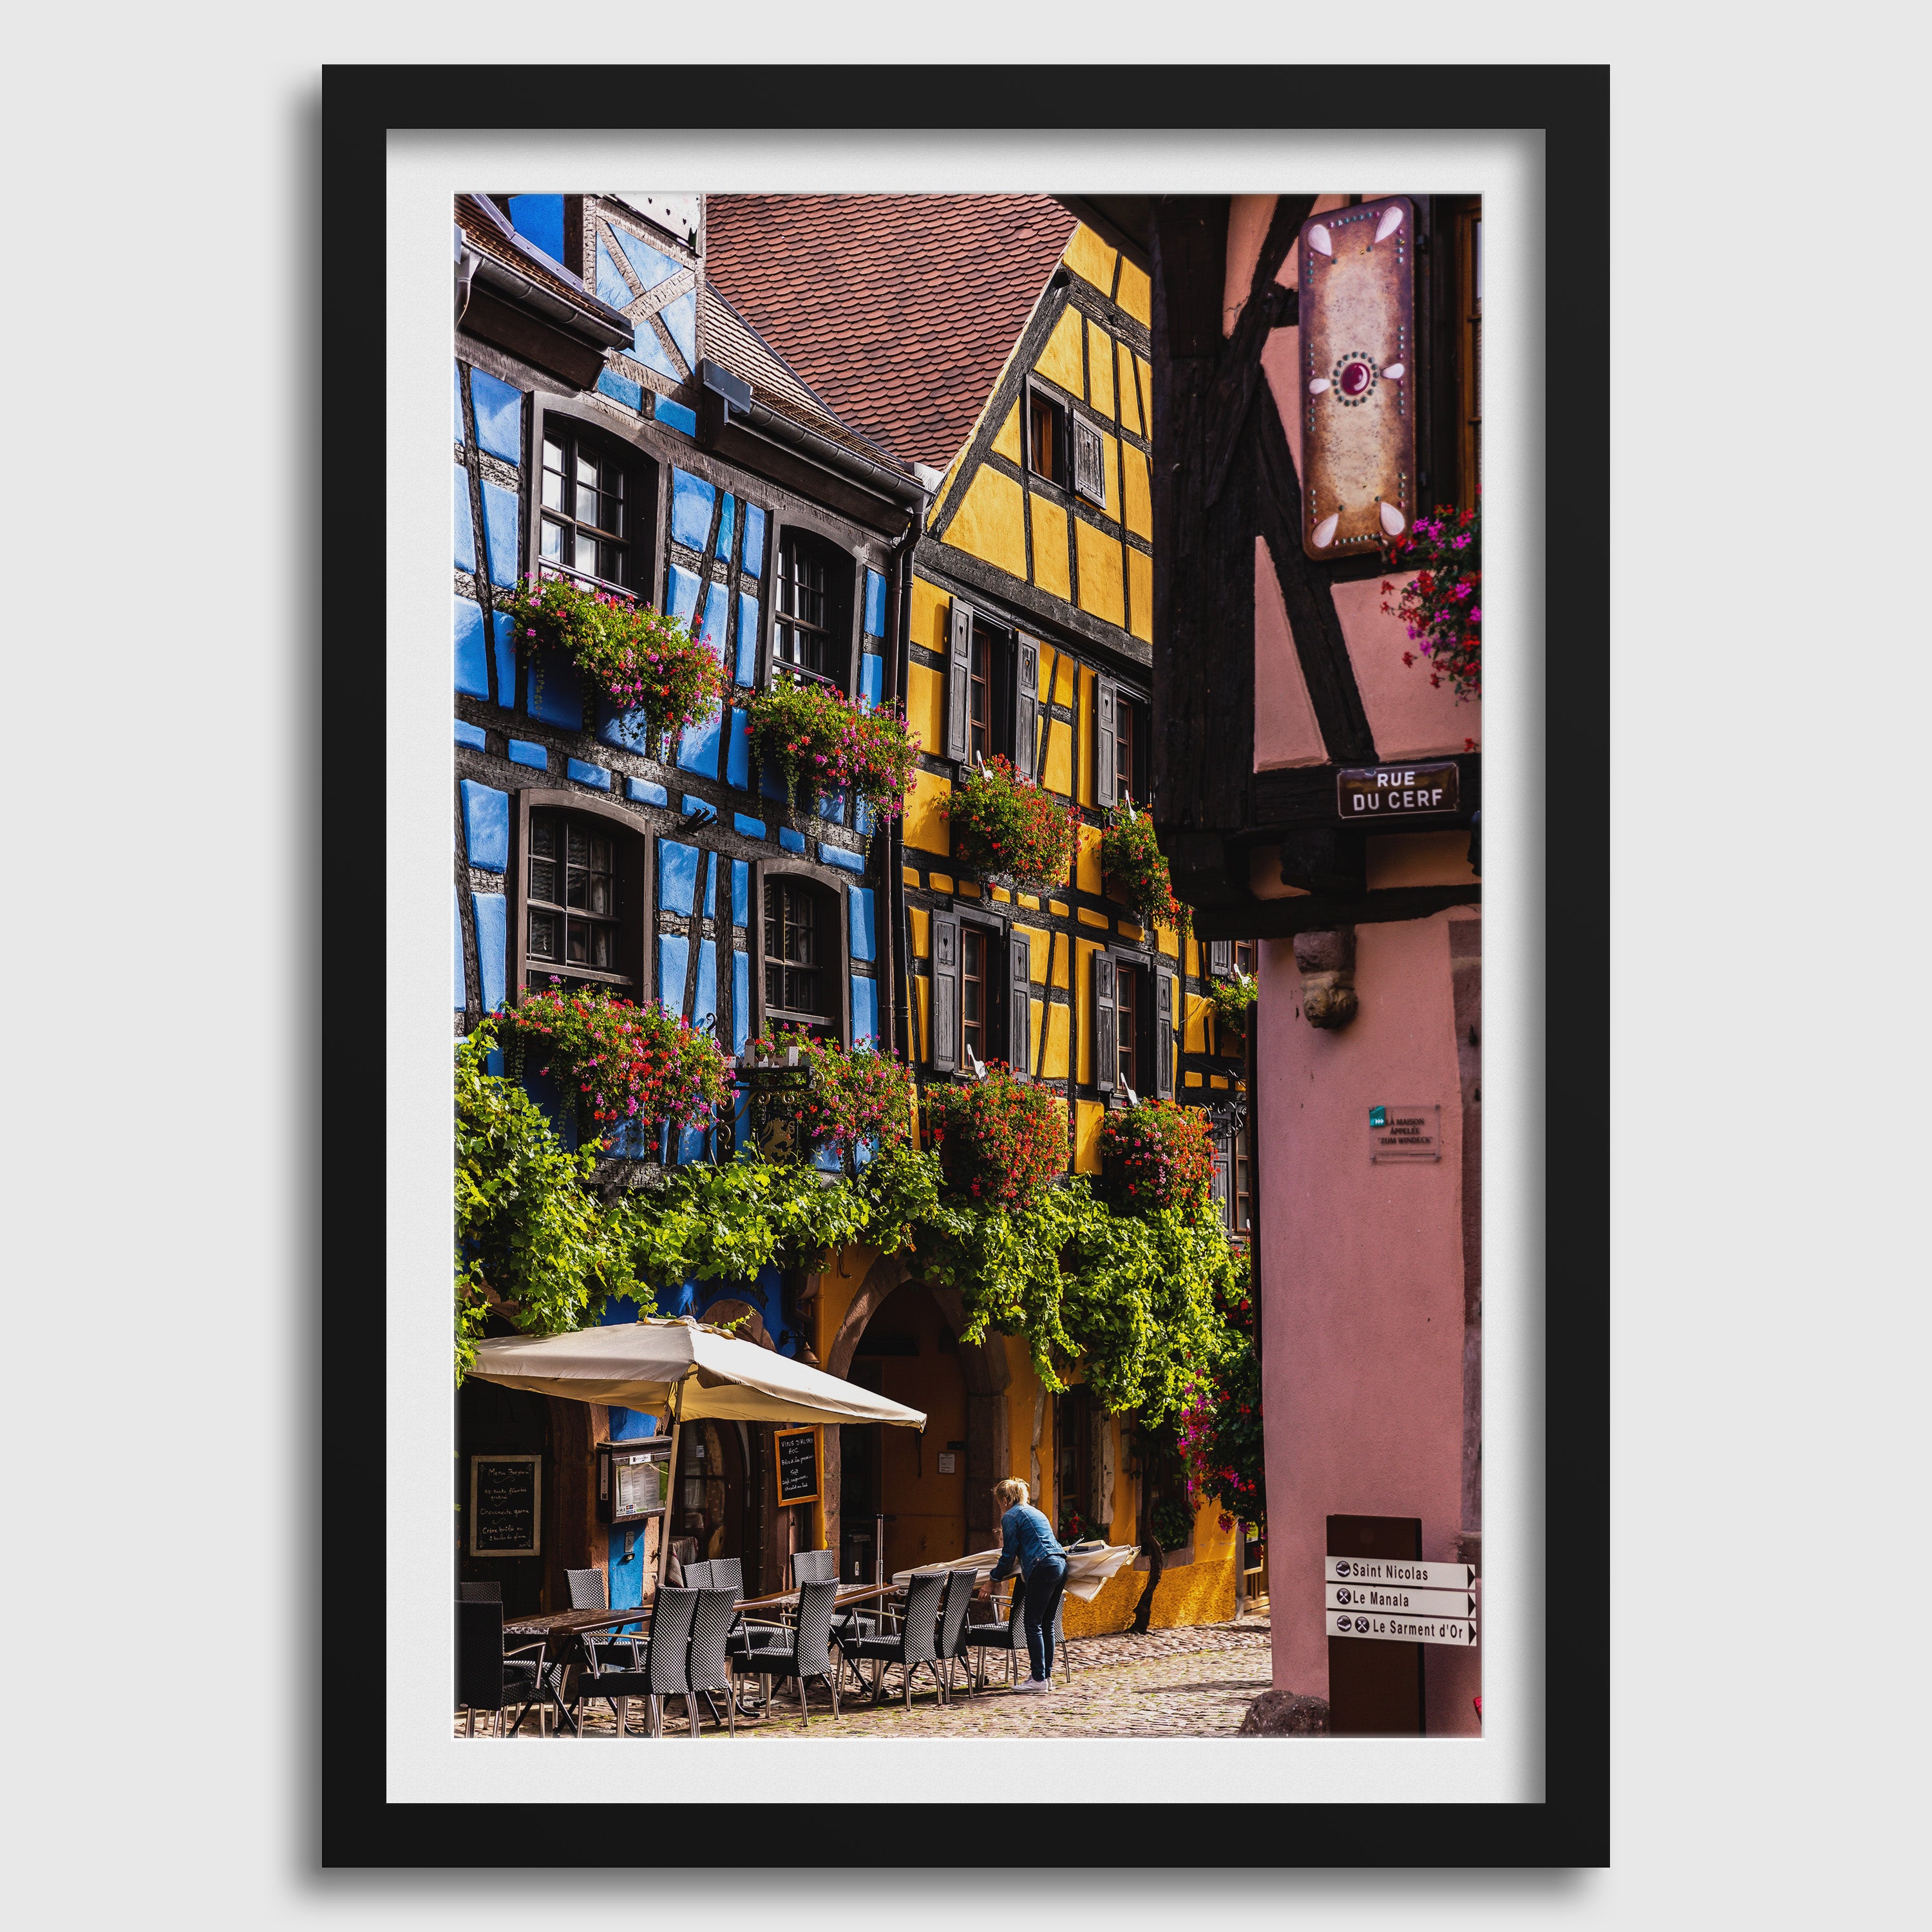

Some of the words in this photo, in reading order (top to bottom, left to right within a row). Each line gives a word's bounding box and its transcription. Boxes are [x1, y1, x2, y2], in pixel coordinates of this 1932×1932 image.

[1377, 772, 1415, 787] RUE
[1353, 793, 1379, 811] DU
[1388, 789, 1443, 809] CERF
[488, 1468, 506, 1476] Menu
[1352, 1562, 1381, 1578] Saint
[1386, 1565, 1428, 1580] Nicolas
[1353, 1590, 1365, 1604] Le
[1370, 1591, 1409, 1607] Manala
[1373, 1619, 1385, 1633] Le
[1390, 1620, 1435, 1637] Sarment
[1439, 1624, 1463, 1639] d'Or
